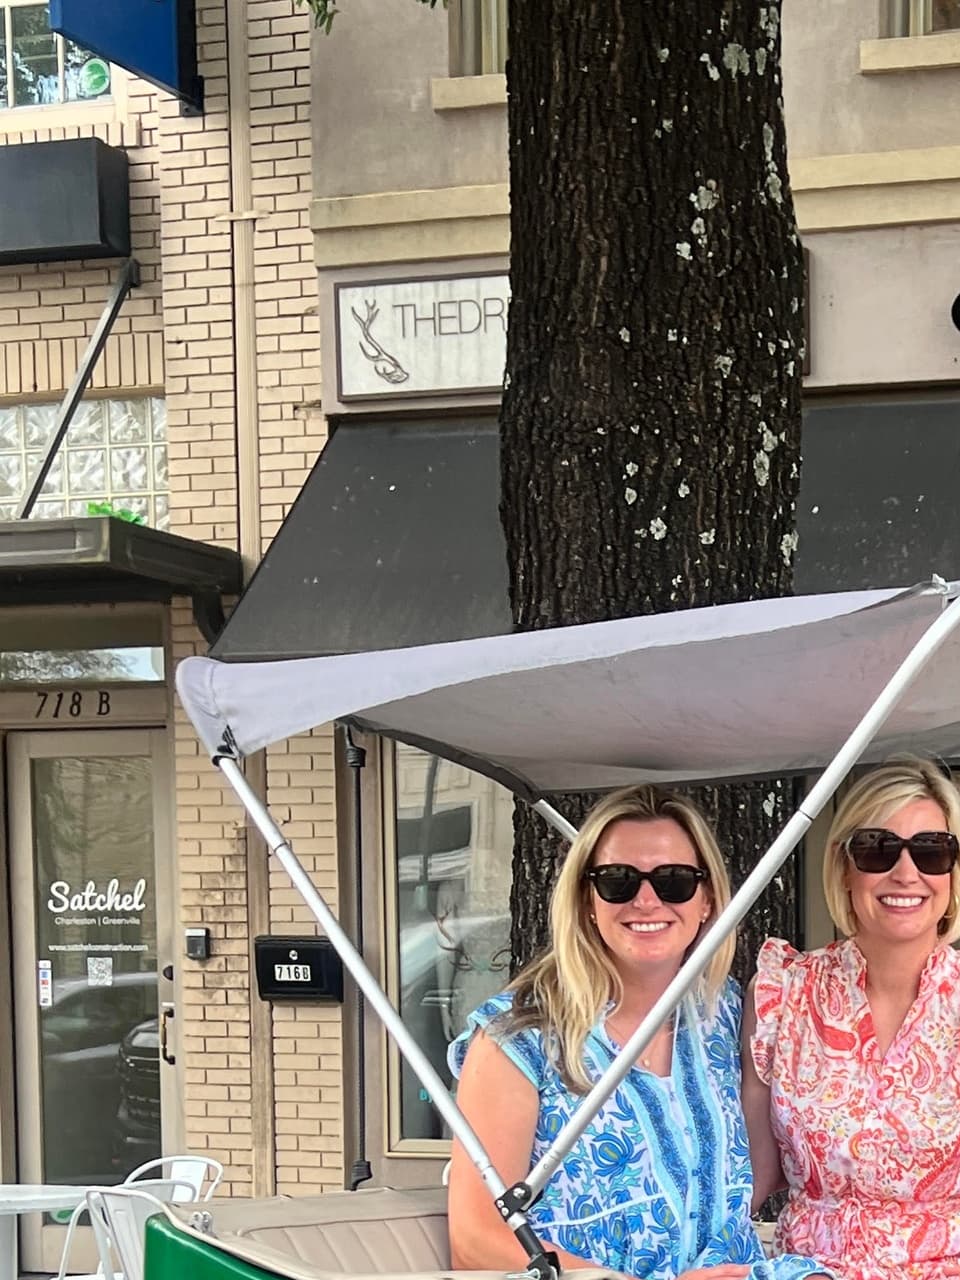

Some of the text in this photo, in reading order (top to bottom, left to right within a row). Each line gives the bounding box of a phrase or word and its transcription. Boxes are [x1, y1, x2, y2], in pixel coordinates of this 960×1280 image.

[392, 296, 511, 339] THEDR
[35, 690, 110, 718] 718 B
[47, 878, 146, 913] Satchel
